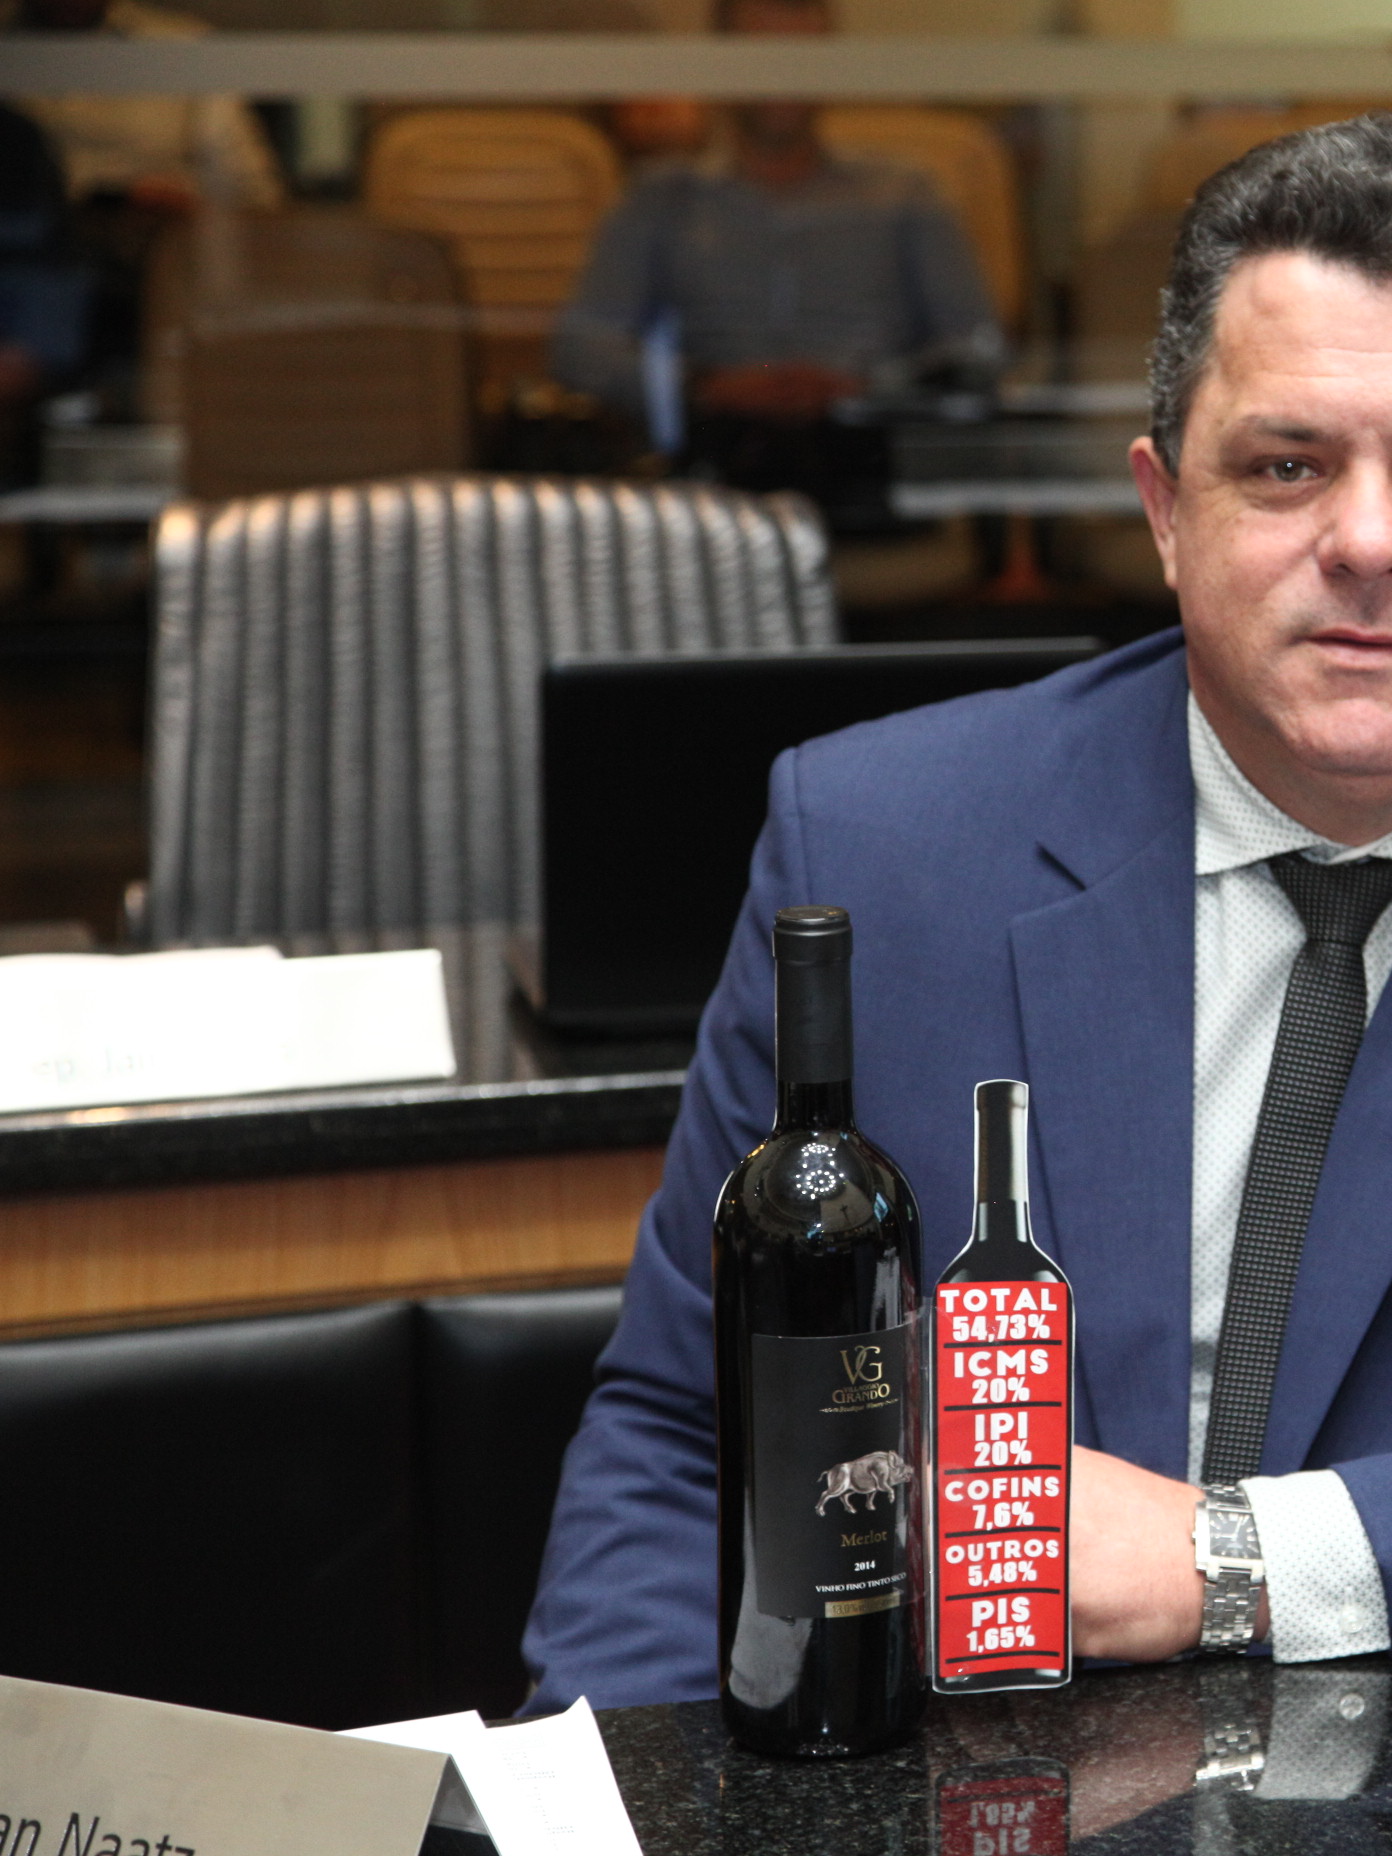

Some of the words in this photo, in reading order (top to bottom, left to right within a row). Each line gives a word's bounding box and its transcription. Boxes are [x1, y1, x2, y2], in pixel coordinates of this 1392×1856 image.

[939, 1287, 1058, 1313] TOTAL
[952, 1314, 1051, 1343] 54,73%
[954, 1349, 1049, 1378] ICMS
[972, 1377, 1030, 1404] 20%
[974, 1411, 1029, 1442] IPI
[974, 1439, 1032, 1467] 20%
[945, 1476, 1060, 1502] COFINS
[972, 1501, 1035, 1531] 7,6%
[841, 1531, 887, 1547] Merlot
[945, 1539, 1060, 1564] OUTROS
[854, 1560, 876, 1572] 2014
[968, 1560, 1037, 1587] 5,48%
[815, 1584, 845, 1593] VINHO
[846, 1581, 866, 1591] FINO
[867, 1577, 891, 1588] TINTO
[972, 1596, 1030, 1628] PIS
[966, 1625, 1035, 1653] 1,65%
[58, 1812, 196, 1856] Naat
